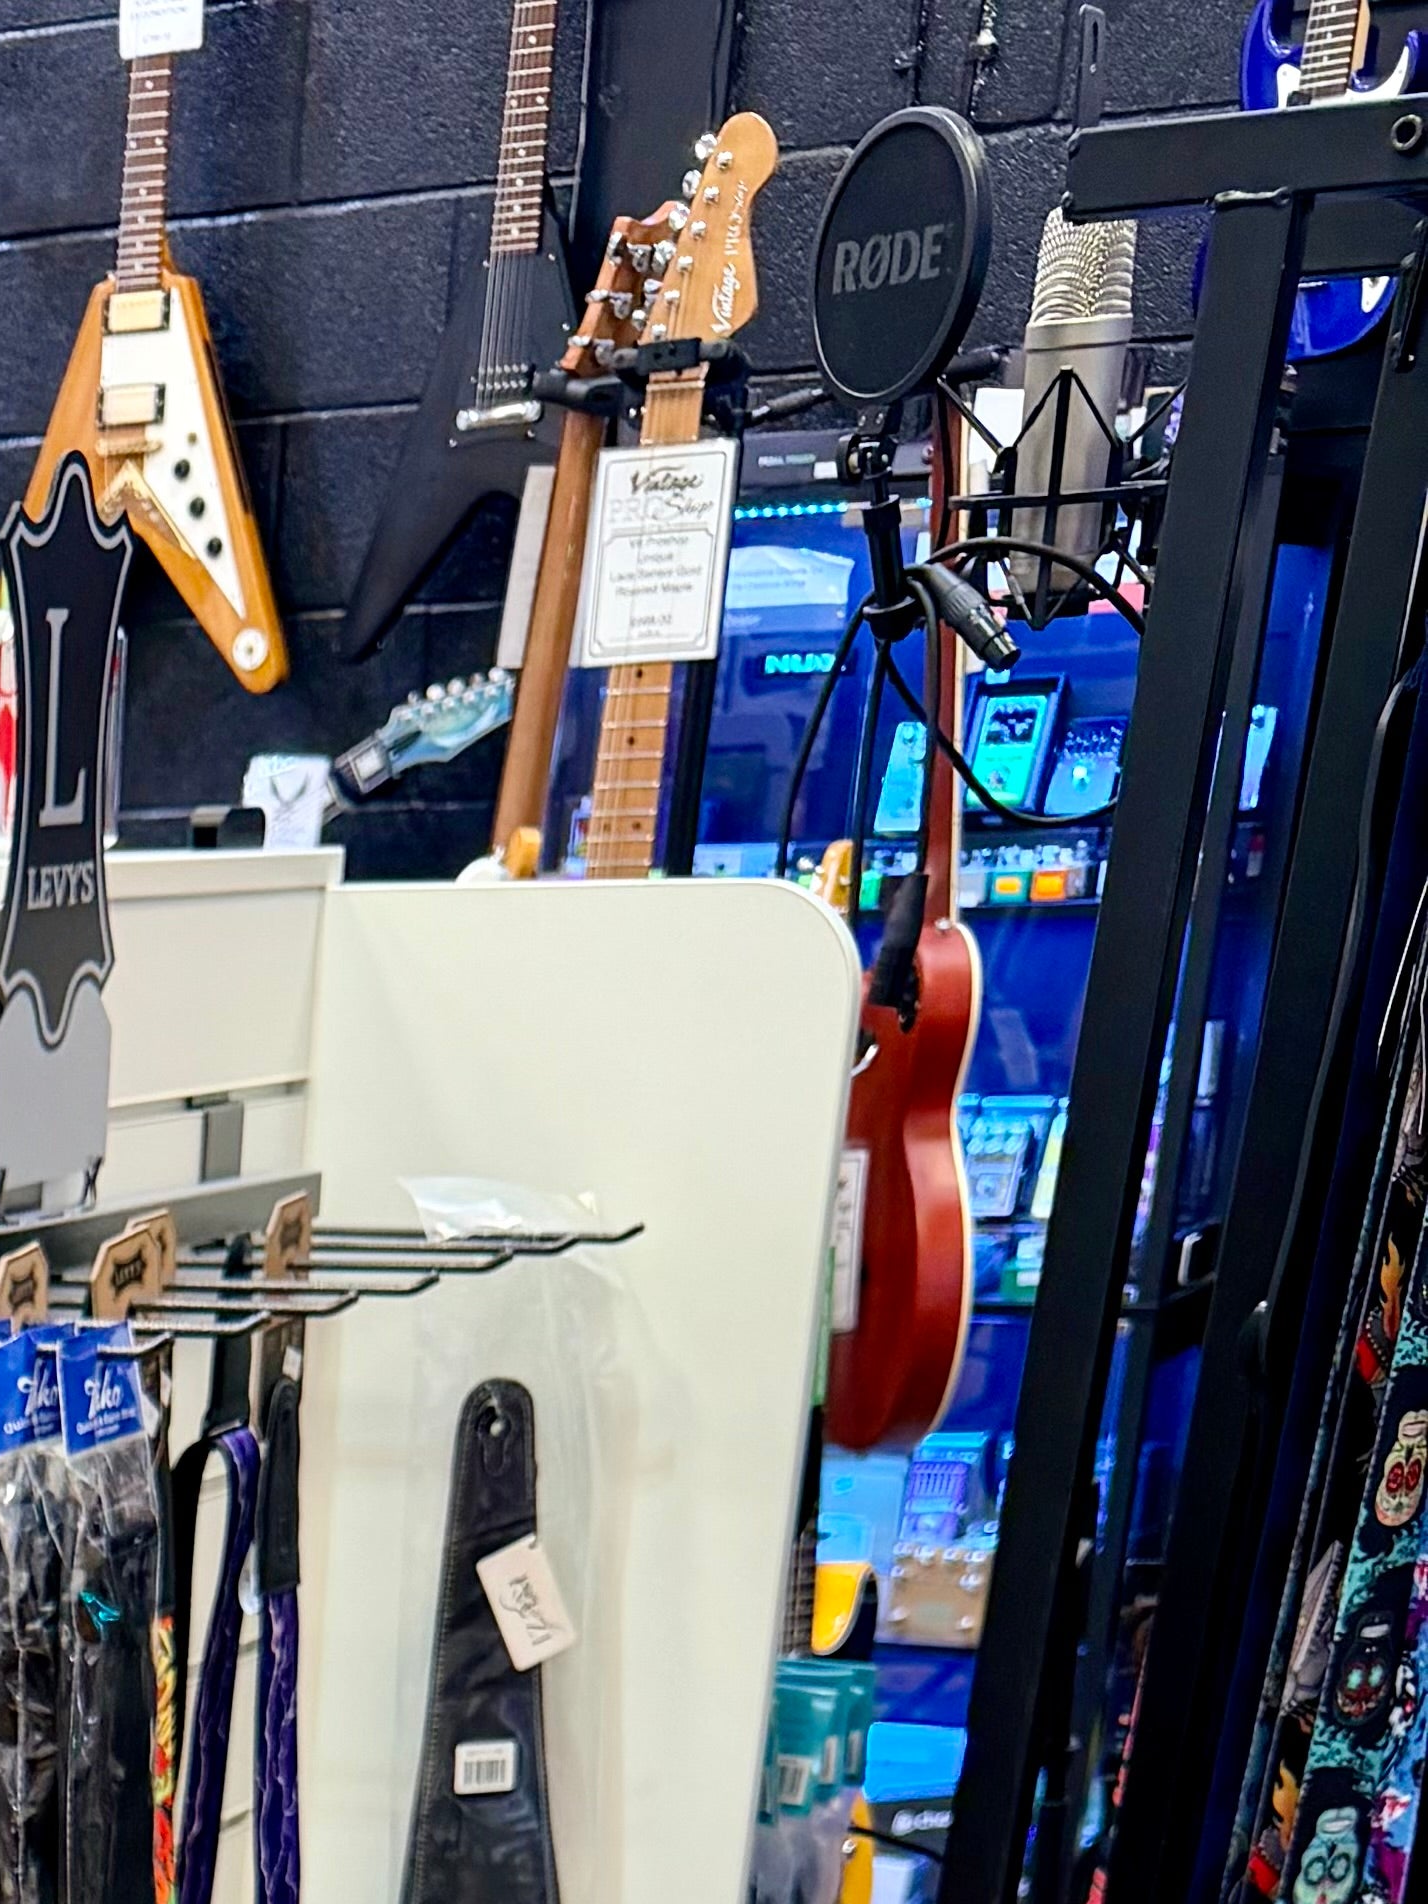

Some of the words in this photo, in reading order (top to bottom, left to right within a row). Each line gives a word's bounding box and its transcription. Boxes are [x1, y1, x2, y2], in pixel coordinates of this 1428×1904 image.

[831, 223, 945, 296] RØDE
[710, 262, 740, 336] Vintage
[630, 465, 704, 495] Vintage
[39, 607, 87, 828] L
[27, 862, 95, 911] LEVY'S
